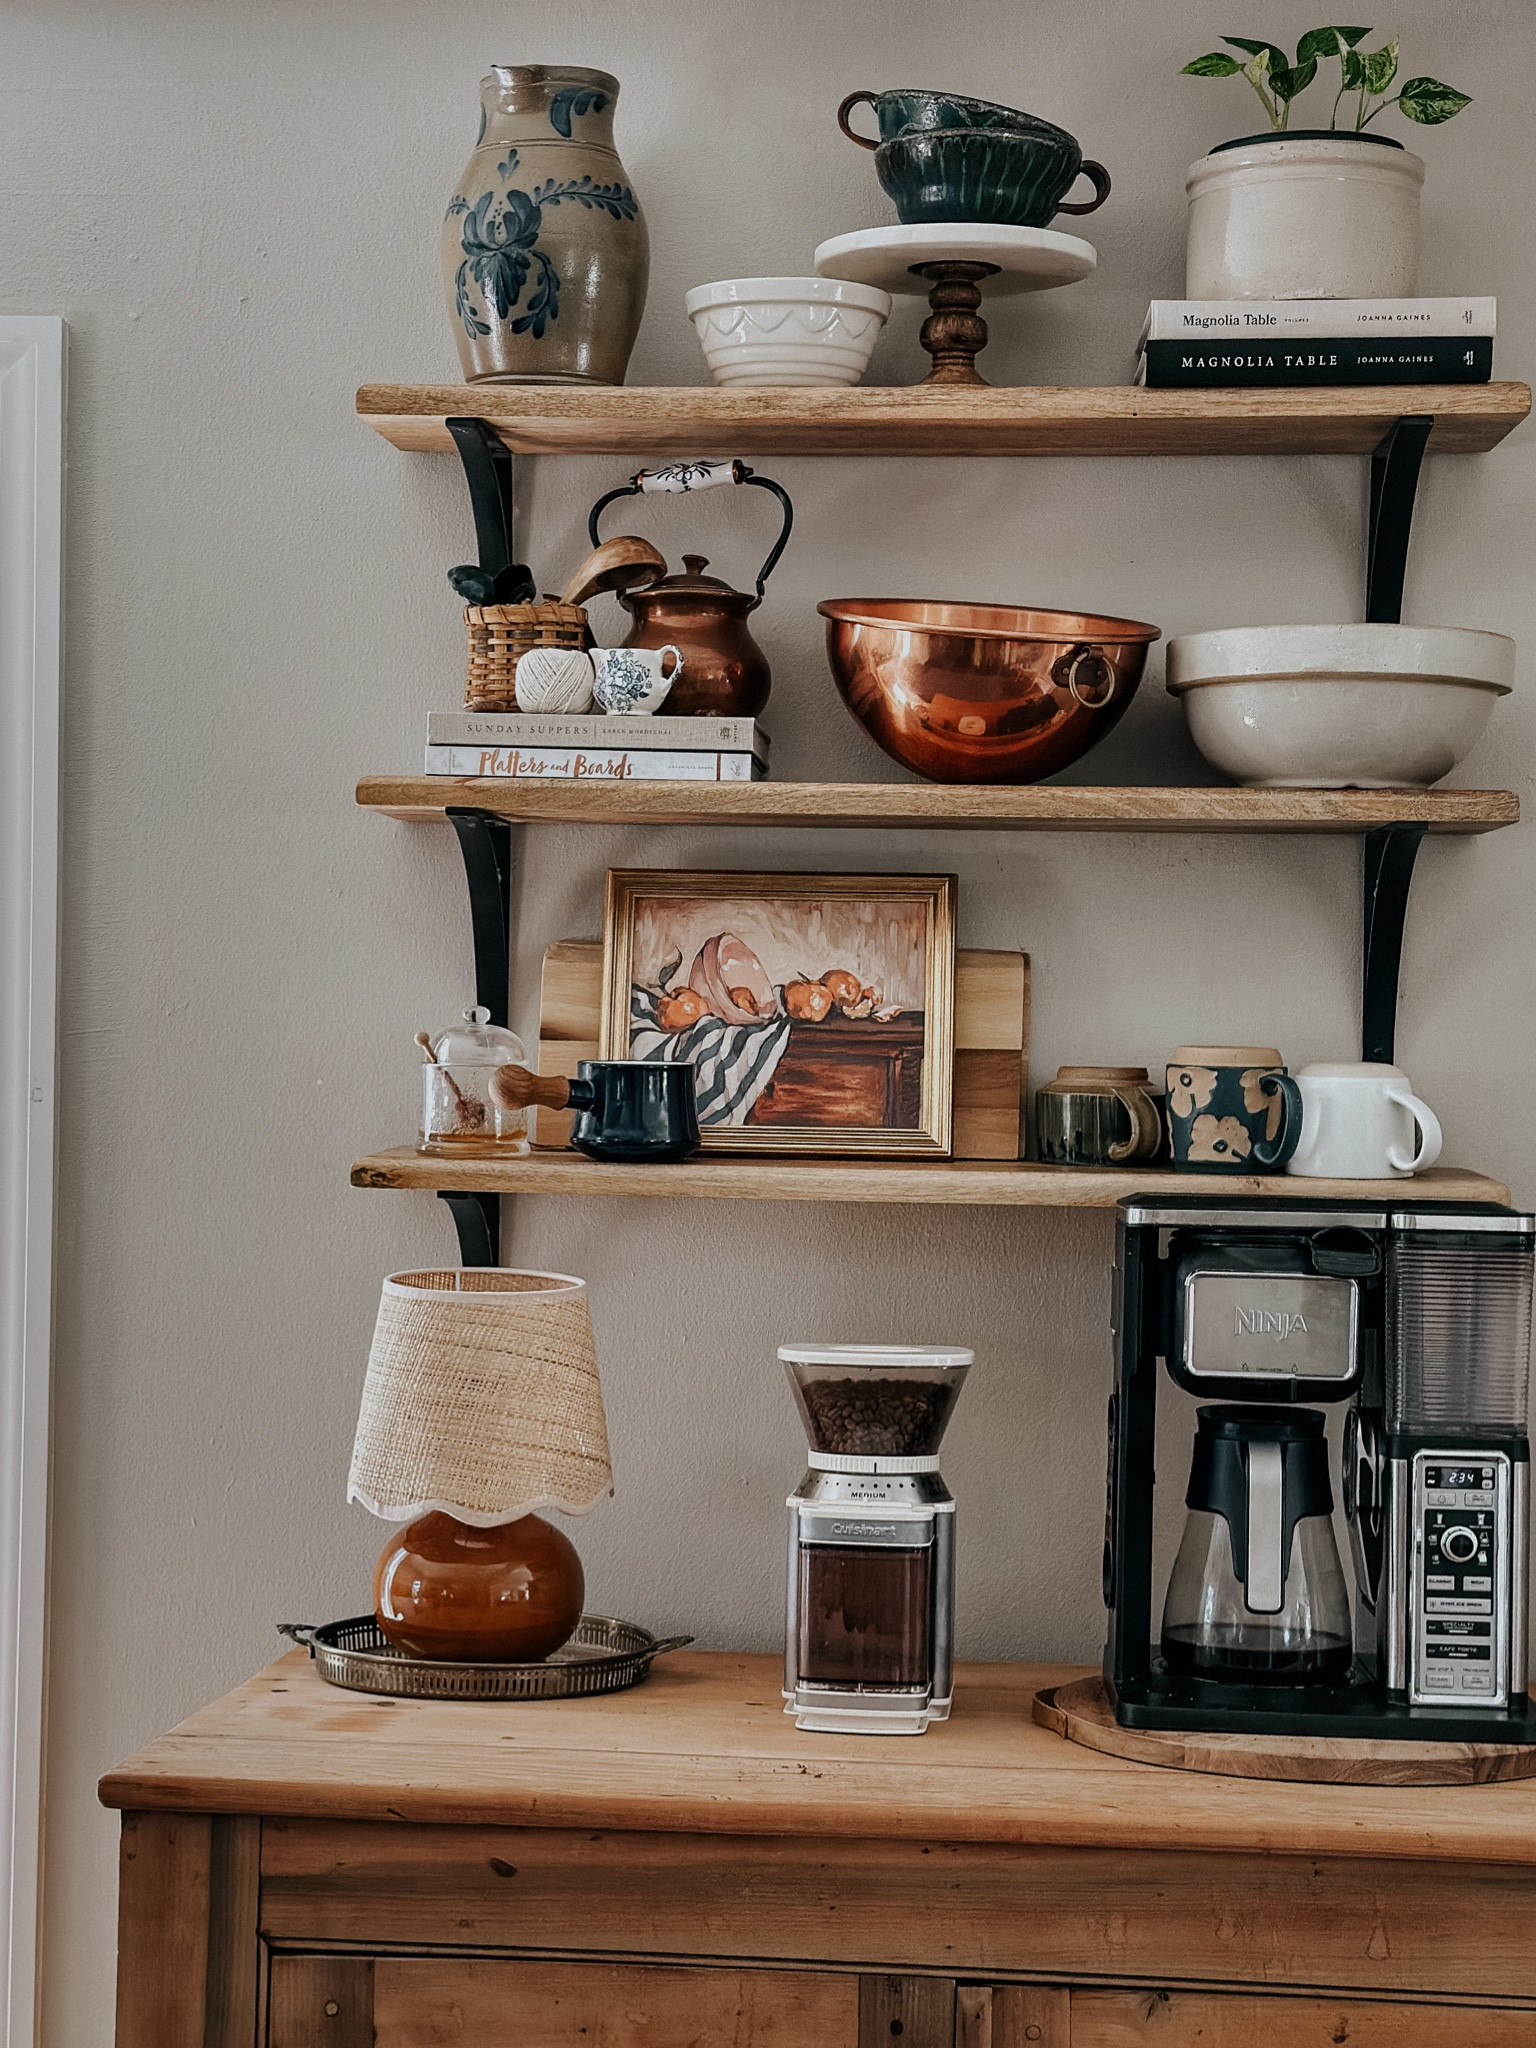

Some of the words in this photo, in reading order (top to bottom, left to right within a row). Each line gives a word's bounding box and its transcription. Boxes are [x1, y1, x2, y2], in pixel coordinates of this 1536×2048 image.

[1182, 315, 1240, 329] Magnolia
[1243, 314, 1277, 326] Table
[1181, 356, 1275, 368] MAGNOLIA
[1284, 355, 1338, 367] TABLE
[1357, 356, 1395, 364] JOANNA
[1398, 355, 1434, 363] GAINES
[467, 724, 522, 733] SUNDAY
[529, 725, 589, 735] SUPPERS
[479, 748, 548, 777] Platters
[550, 759, 570, 774] and
[573, 753, 634, 779] Boards
[1234, 1305, 1308, 1341] NINJA
[1448, 1472, 1475, 1483] 2:34
[850, 1491, 886, 1499] MEDIUM
[831, 1522, 896, 1536] Cuisinart
